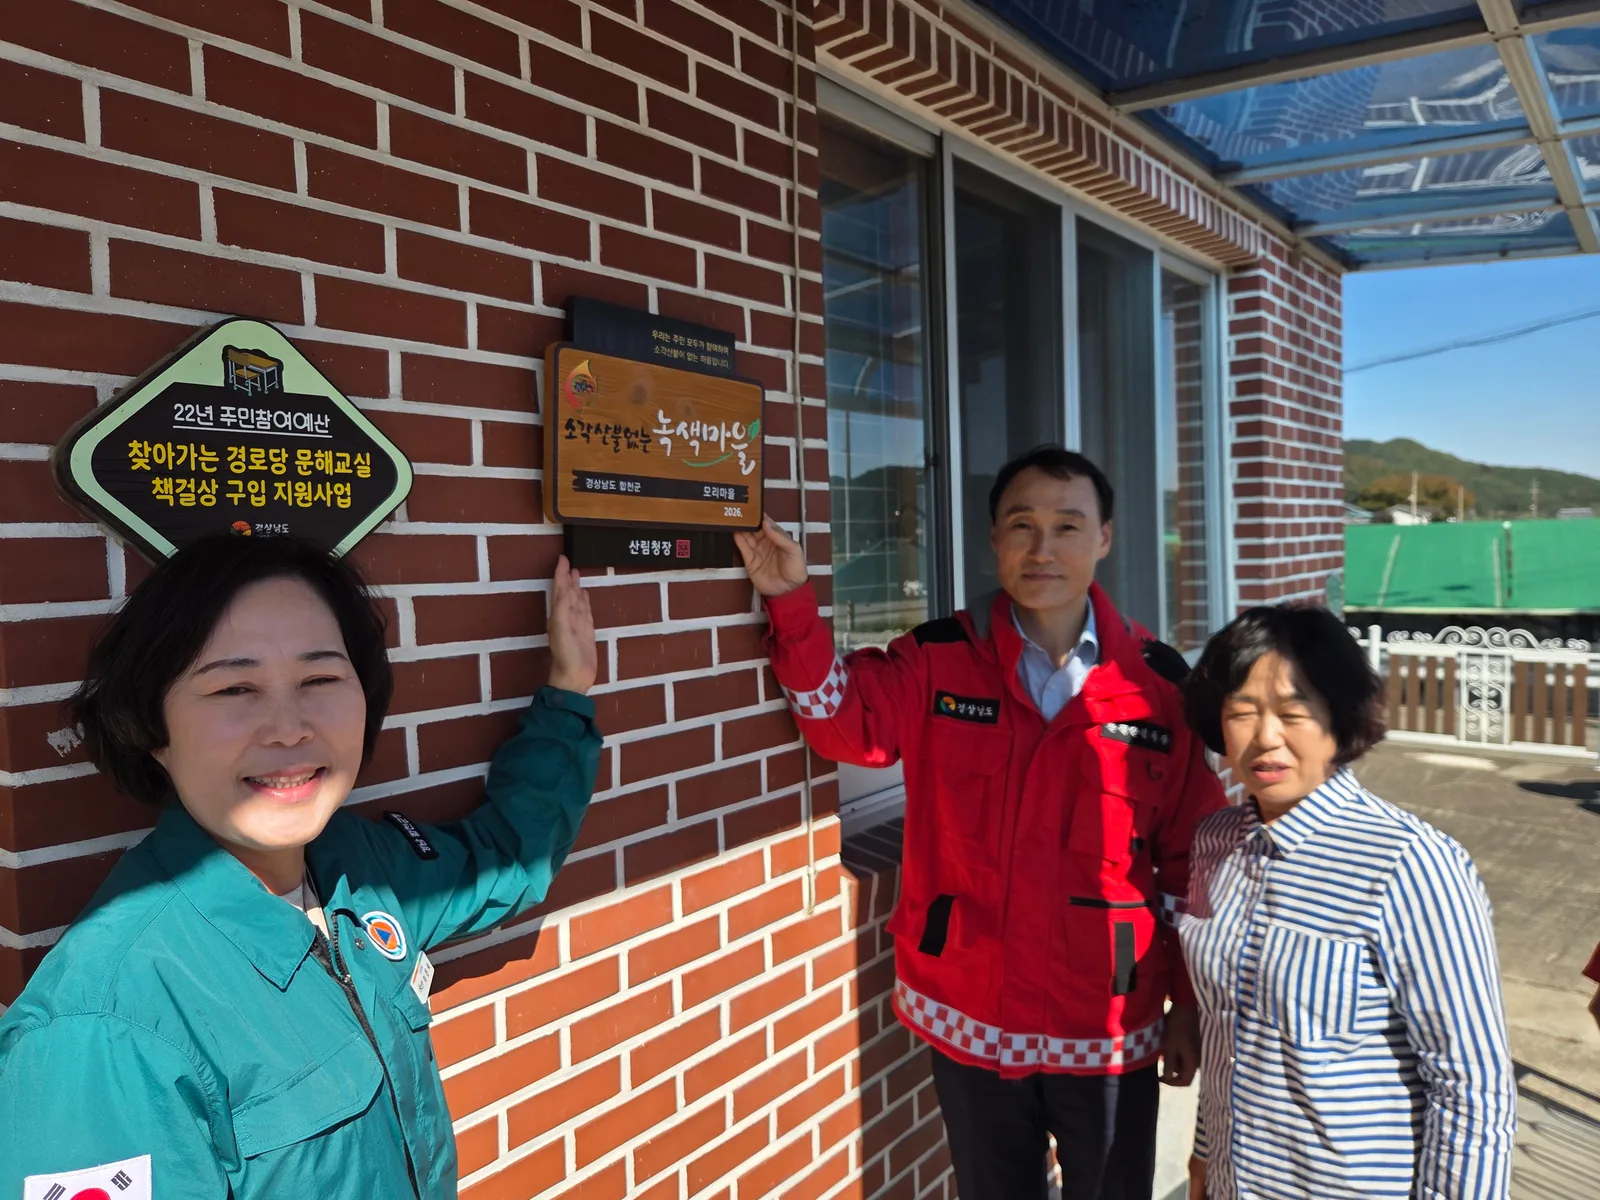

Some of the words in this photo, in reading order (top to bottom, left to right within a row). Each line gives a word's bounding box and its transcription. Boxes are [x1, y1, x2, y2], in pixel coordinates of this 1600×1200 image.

[652, 330, 671, 343] 우리는
[673, 334, 686, 346] 주민
[687, 338, 705, 351] 모두가
[706, 341, 729, 356] 참여하여
[654, 345, 686, 360] 소각산불이
[687, 351, 699, 363] 없는
[173, 403, 214, 426] 22년
[219, 405, 331, 434] 주민참여예산
[652, 409, 756, 476] 녹색마을
[128, 439, 220, 474] 찾아가는
[226, 445, 288, 476] 경로당
[294, 449, 372, 479] 문해교실
[151, 476, 219, 507] 책걸상
[225, 478, 266, 507] 구입
[273, 480, 352, 509] 지원사업
[586, 478, 617, 491] 경상남도
[619, 481, 642, 493] 합천군
[703, 485, 736, 500] 모리마을
[724, 506, 743, 518] 2026.
[255, 523, 289, 534] 경상남도
[628, 539, 673, 556] 산림청장
[957, 703, 994, 717] 경상남도
